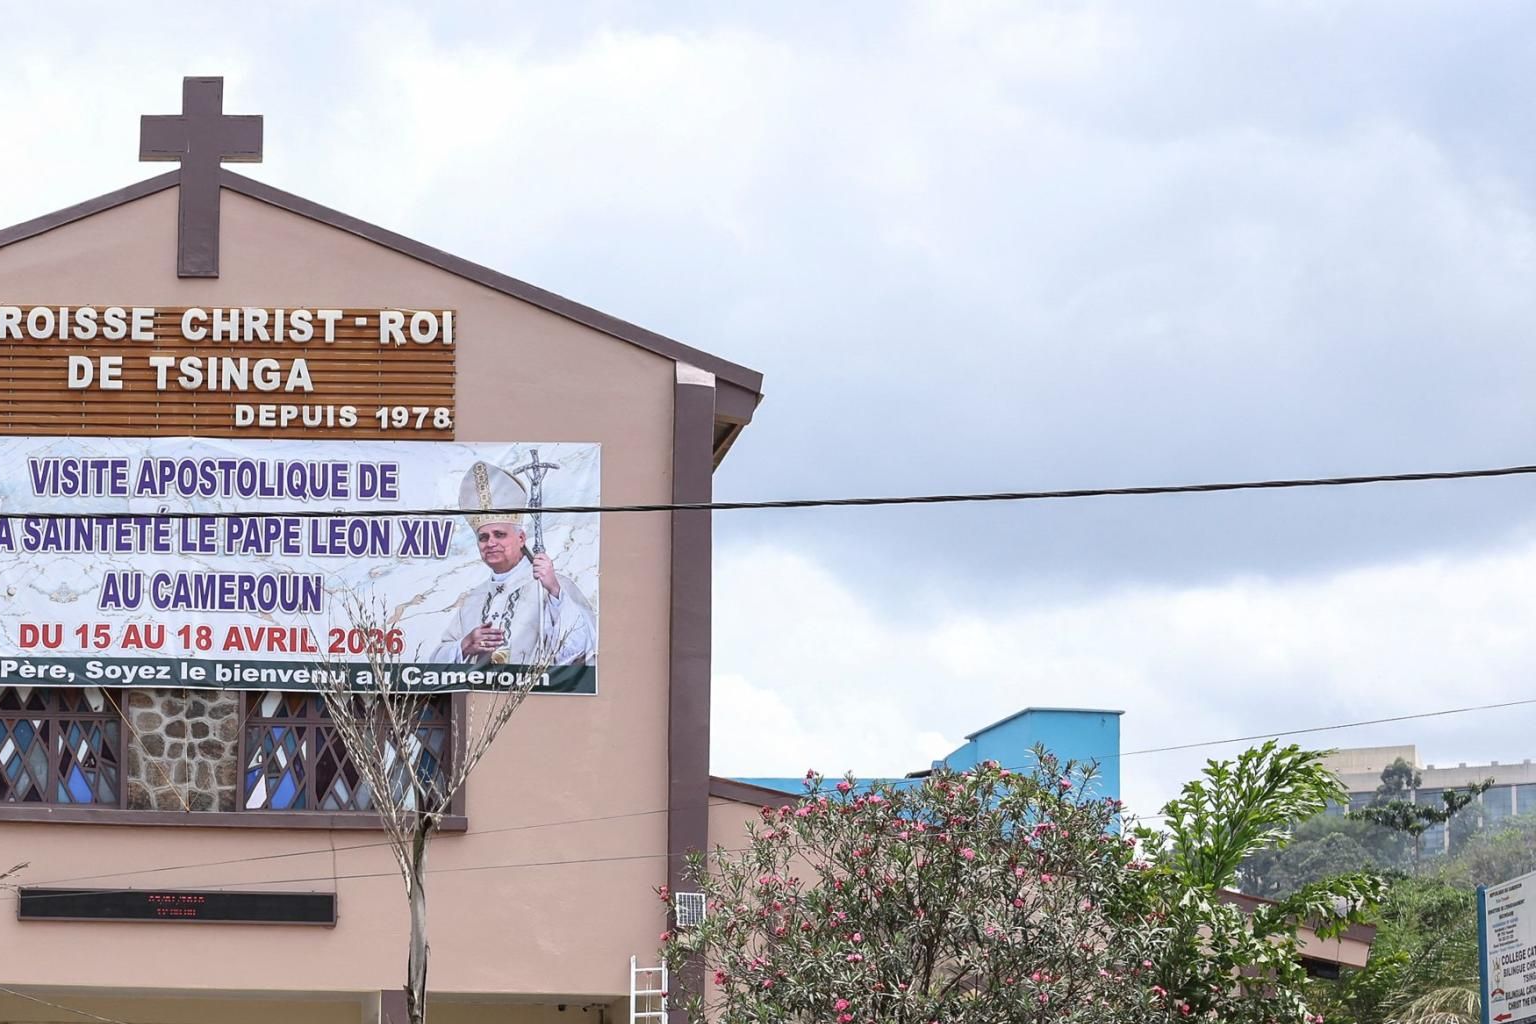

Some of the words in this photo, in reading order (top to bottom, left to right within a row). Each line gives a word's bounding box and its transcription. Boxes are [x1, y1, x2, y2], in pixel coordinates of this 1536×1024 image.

[68, 355, 123, 390] DE
[149, 356, 314, 392] TSINGA
[235, 404, 358, 428] DEPUIS
[375, 406, 451, 430] 1978
[30, 459, 128, 496] VISITE
[137, 460, 349, 500] APOSTOLIQUE
[360, 463, 398, 499] DE
[23, 507, 171, 552] SAINTETÉ
[181, 516, 217, 553] LE
[228, 517, 301, 554] PAPE
[400, 519, 453, 557] XIV
[100, 572, 144, 610] AU
[152, 573, 322, 612] CAMEROUN
[19, 623, 63, 649] DU
[75, 623, 112, 650] 15
[121, 624, 165, 650] AU
[178, 625, 213, 651] 18
[223, 626, 318, 653] AVRIL
[328, 627, 404, 654] 2026
[0, 659, 75, 683] Père,
[85, 660, 171, 684] Soyez
[180, 662, 207, 681] le
[215, 663, 347, 684] bienvenu
[401, 665, 550, 687] Cameroun
[1501, 949, 1526, 966] COLLEGE
